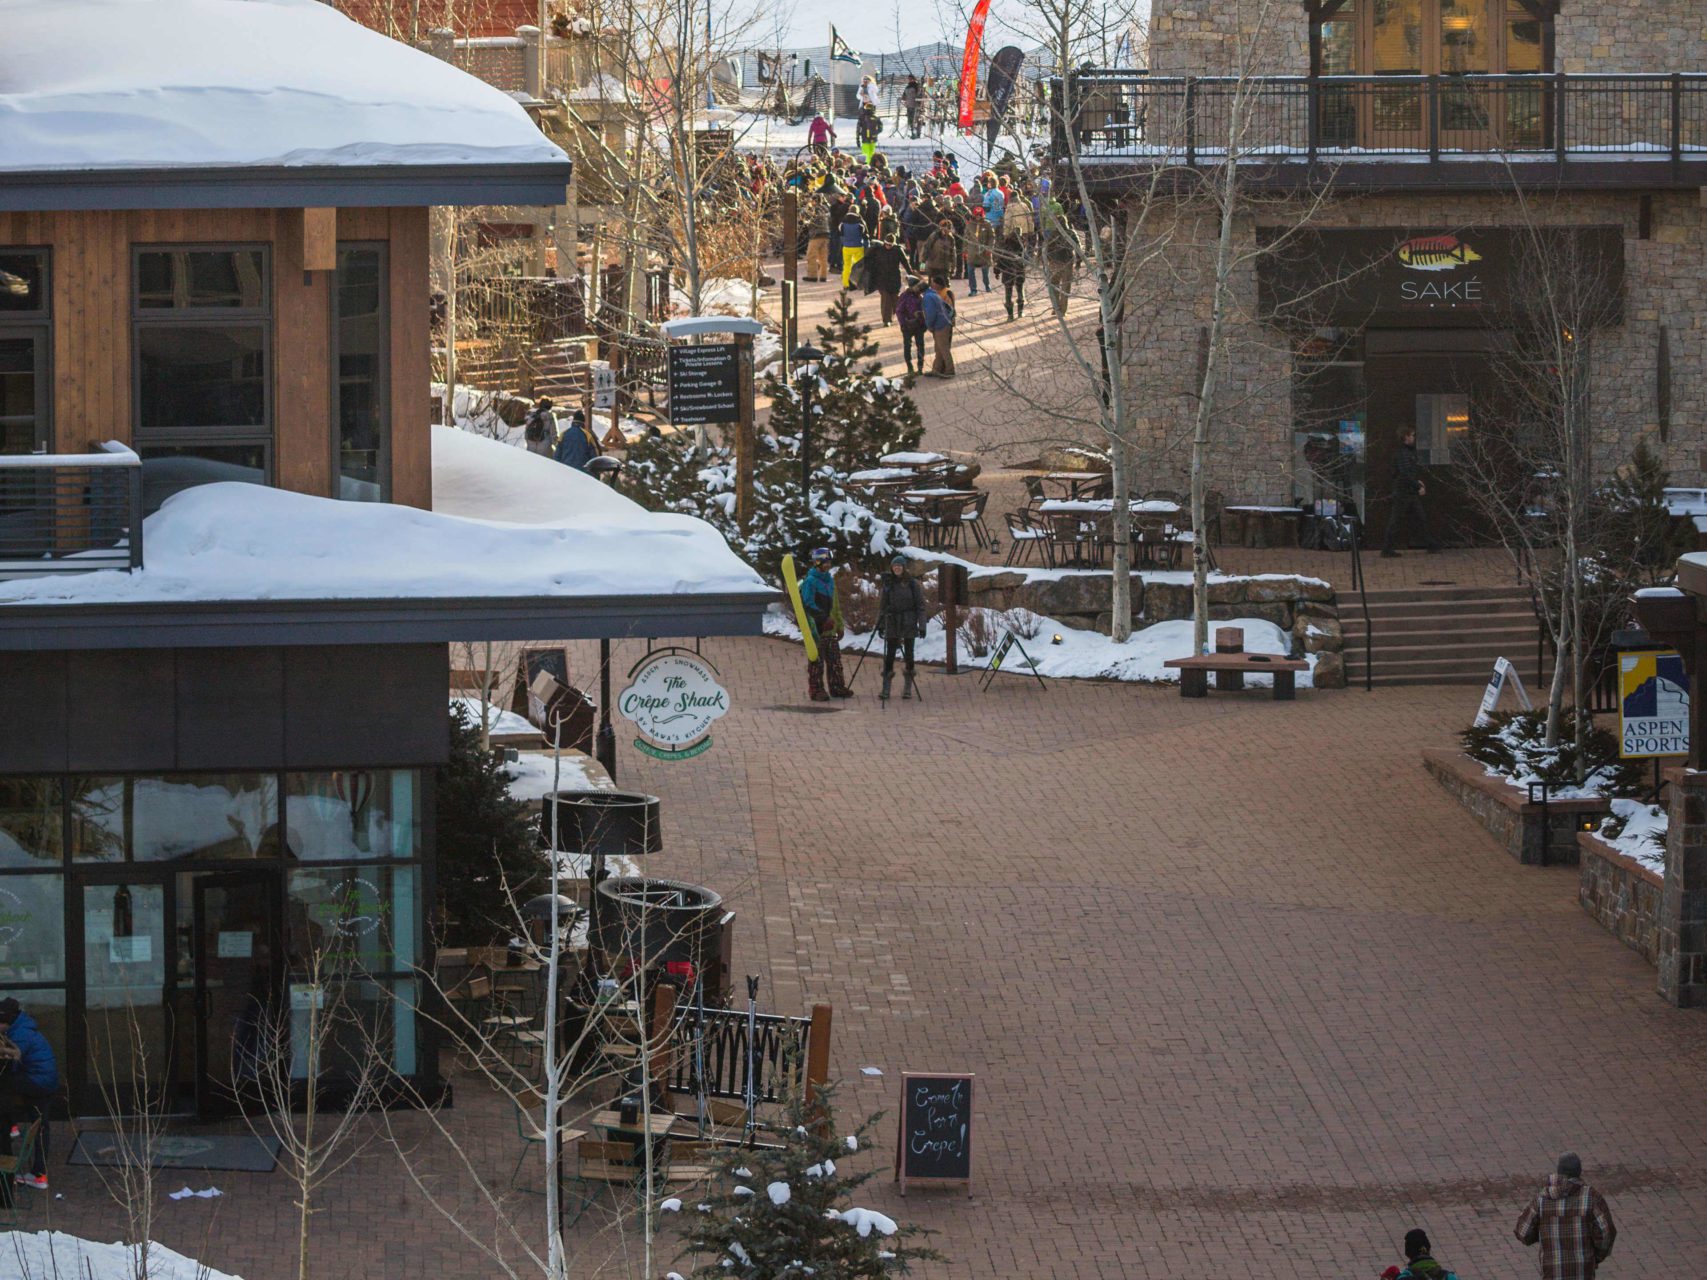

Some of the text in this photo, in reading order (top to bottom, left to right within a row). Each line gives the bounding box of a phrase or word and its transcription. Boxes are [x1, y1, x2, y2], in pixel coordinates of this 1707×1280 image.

[1400, 275, 1482, 300] SAKÉ
[641, 659, 709, 683] ASPEN SNOWMASS
[663, 676, 687, 693] The
[624, 691, 725, 714] Crêpe Shack
[685, 715, 711, 739] KITCHEN
[1624, 720, 1683, 736] ASPEN
[1624, 736, 1690, 753] SPORTS
